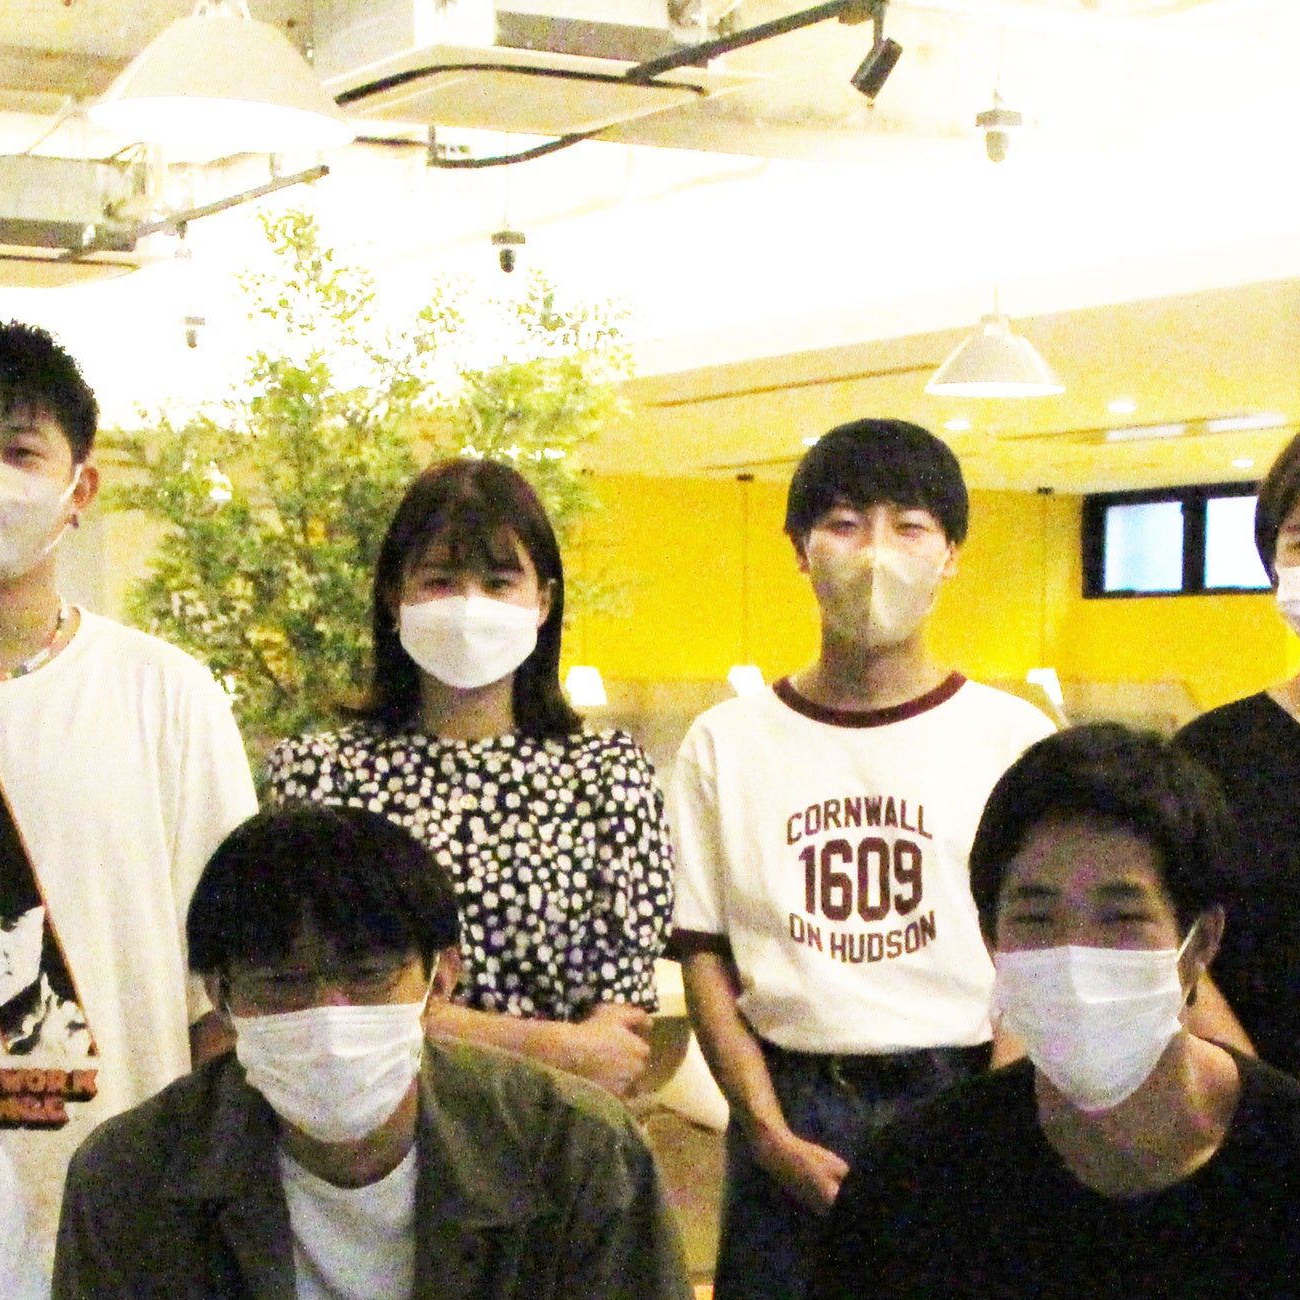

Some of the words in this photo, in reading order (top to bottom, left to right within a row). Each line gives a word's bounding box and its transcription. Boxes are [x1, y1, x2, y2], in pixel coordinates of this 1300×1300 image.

[786, 796, 933, 845] CORNWALL
[798, 836, 923, 922] 1609
[789, 912, 823, 951] ON
[830, 909, 936, 963] HUDSON
